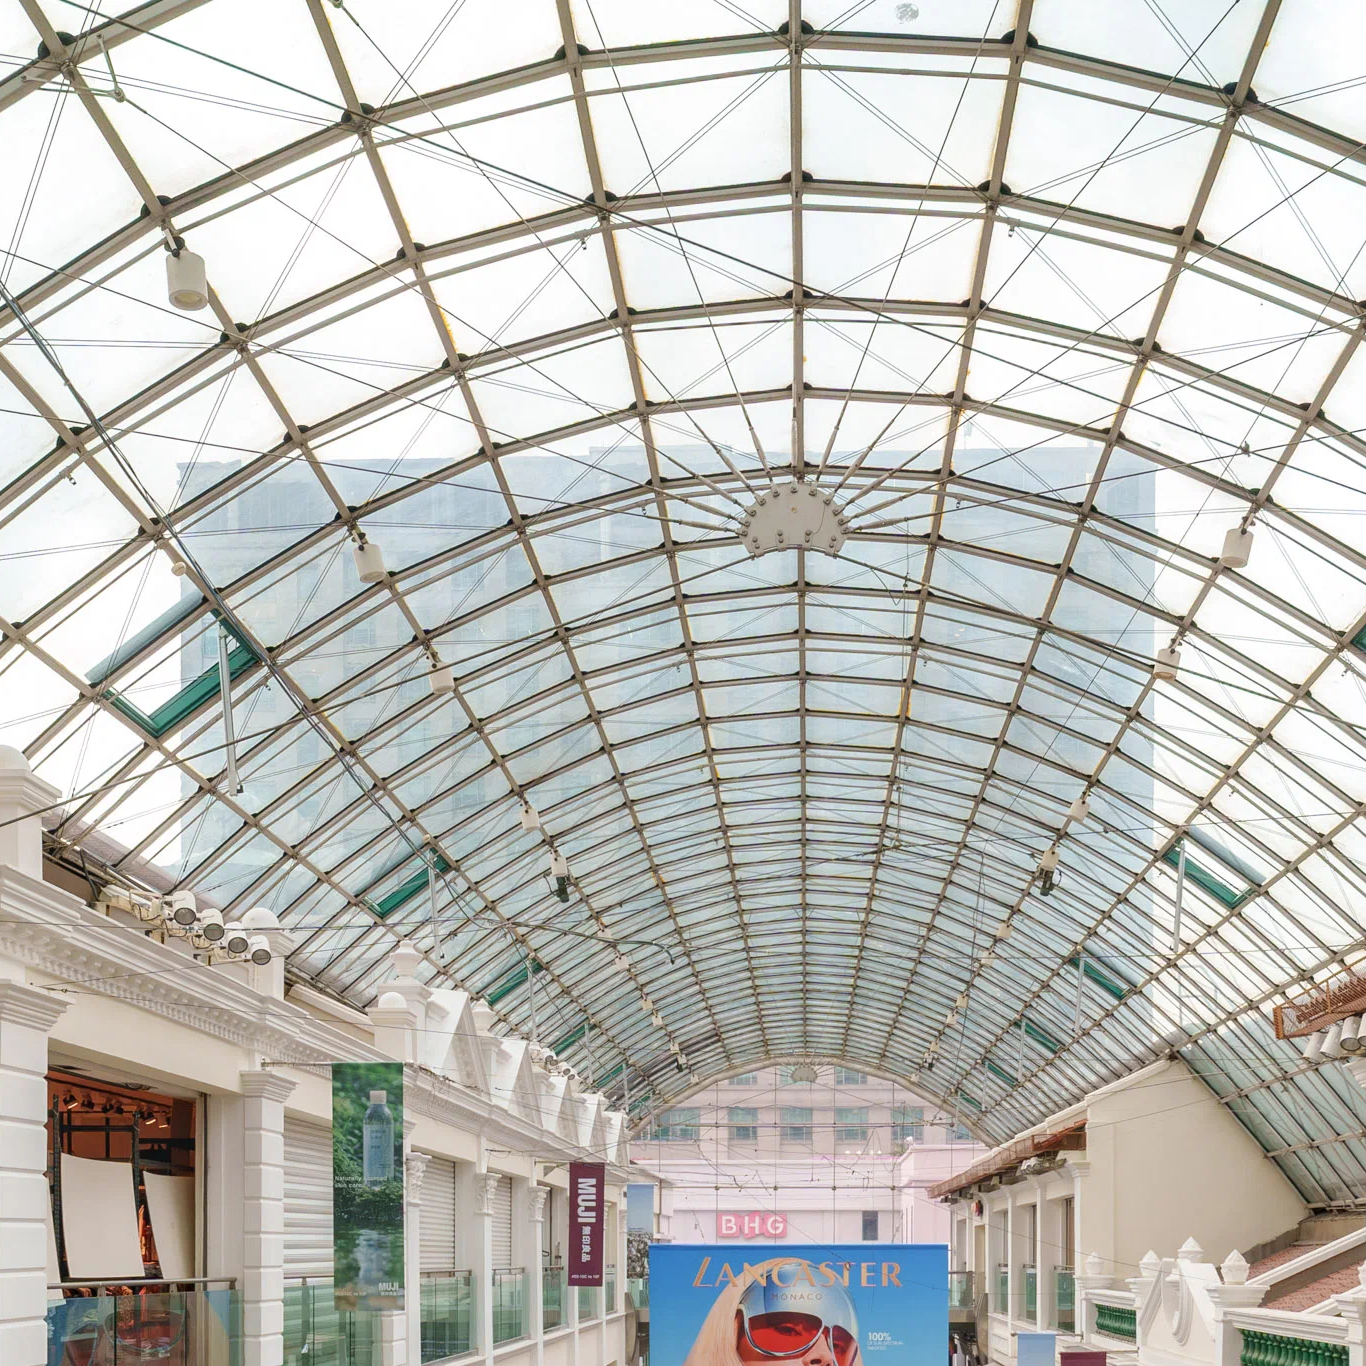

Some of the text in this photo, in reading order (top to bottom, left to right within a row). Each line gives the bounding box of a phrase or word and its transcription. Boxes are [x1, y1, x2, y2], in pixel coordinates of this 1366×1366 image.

[577, 1178, 597, 1223] MUJI
[721, 1215, 785, 1234] BHG
[693, 1257, 903, 1288] LANCASTER
[378, 1282, 400, 1291] MUJI
[771, 1293, 823, 1301] MONACO
[868, 1332, 892, 1341] 100%
